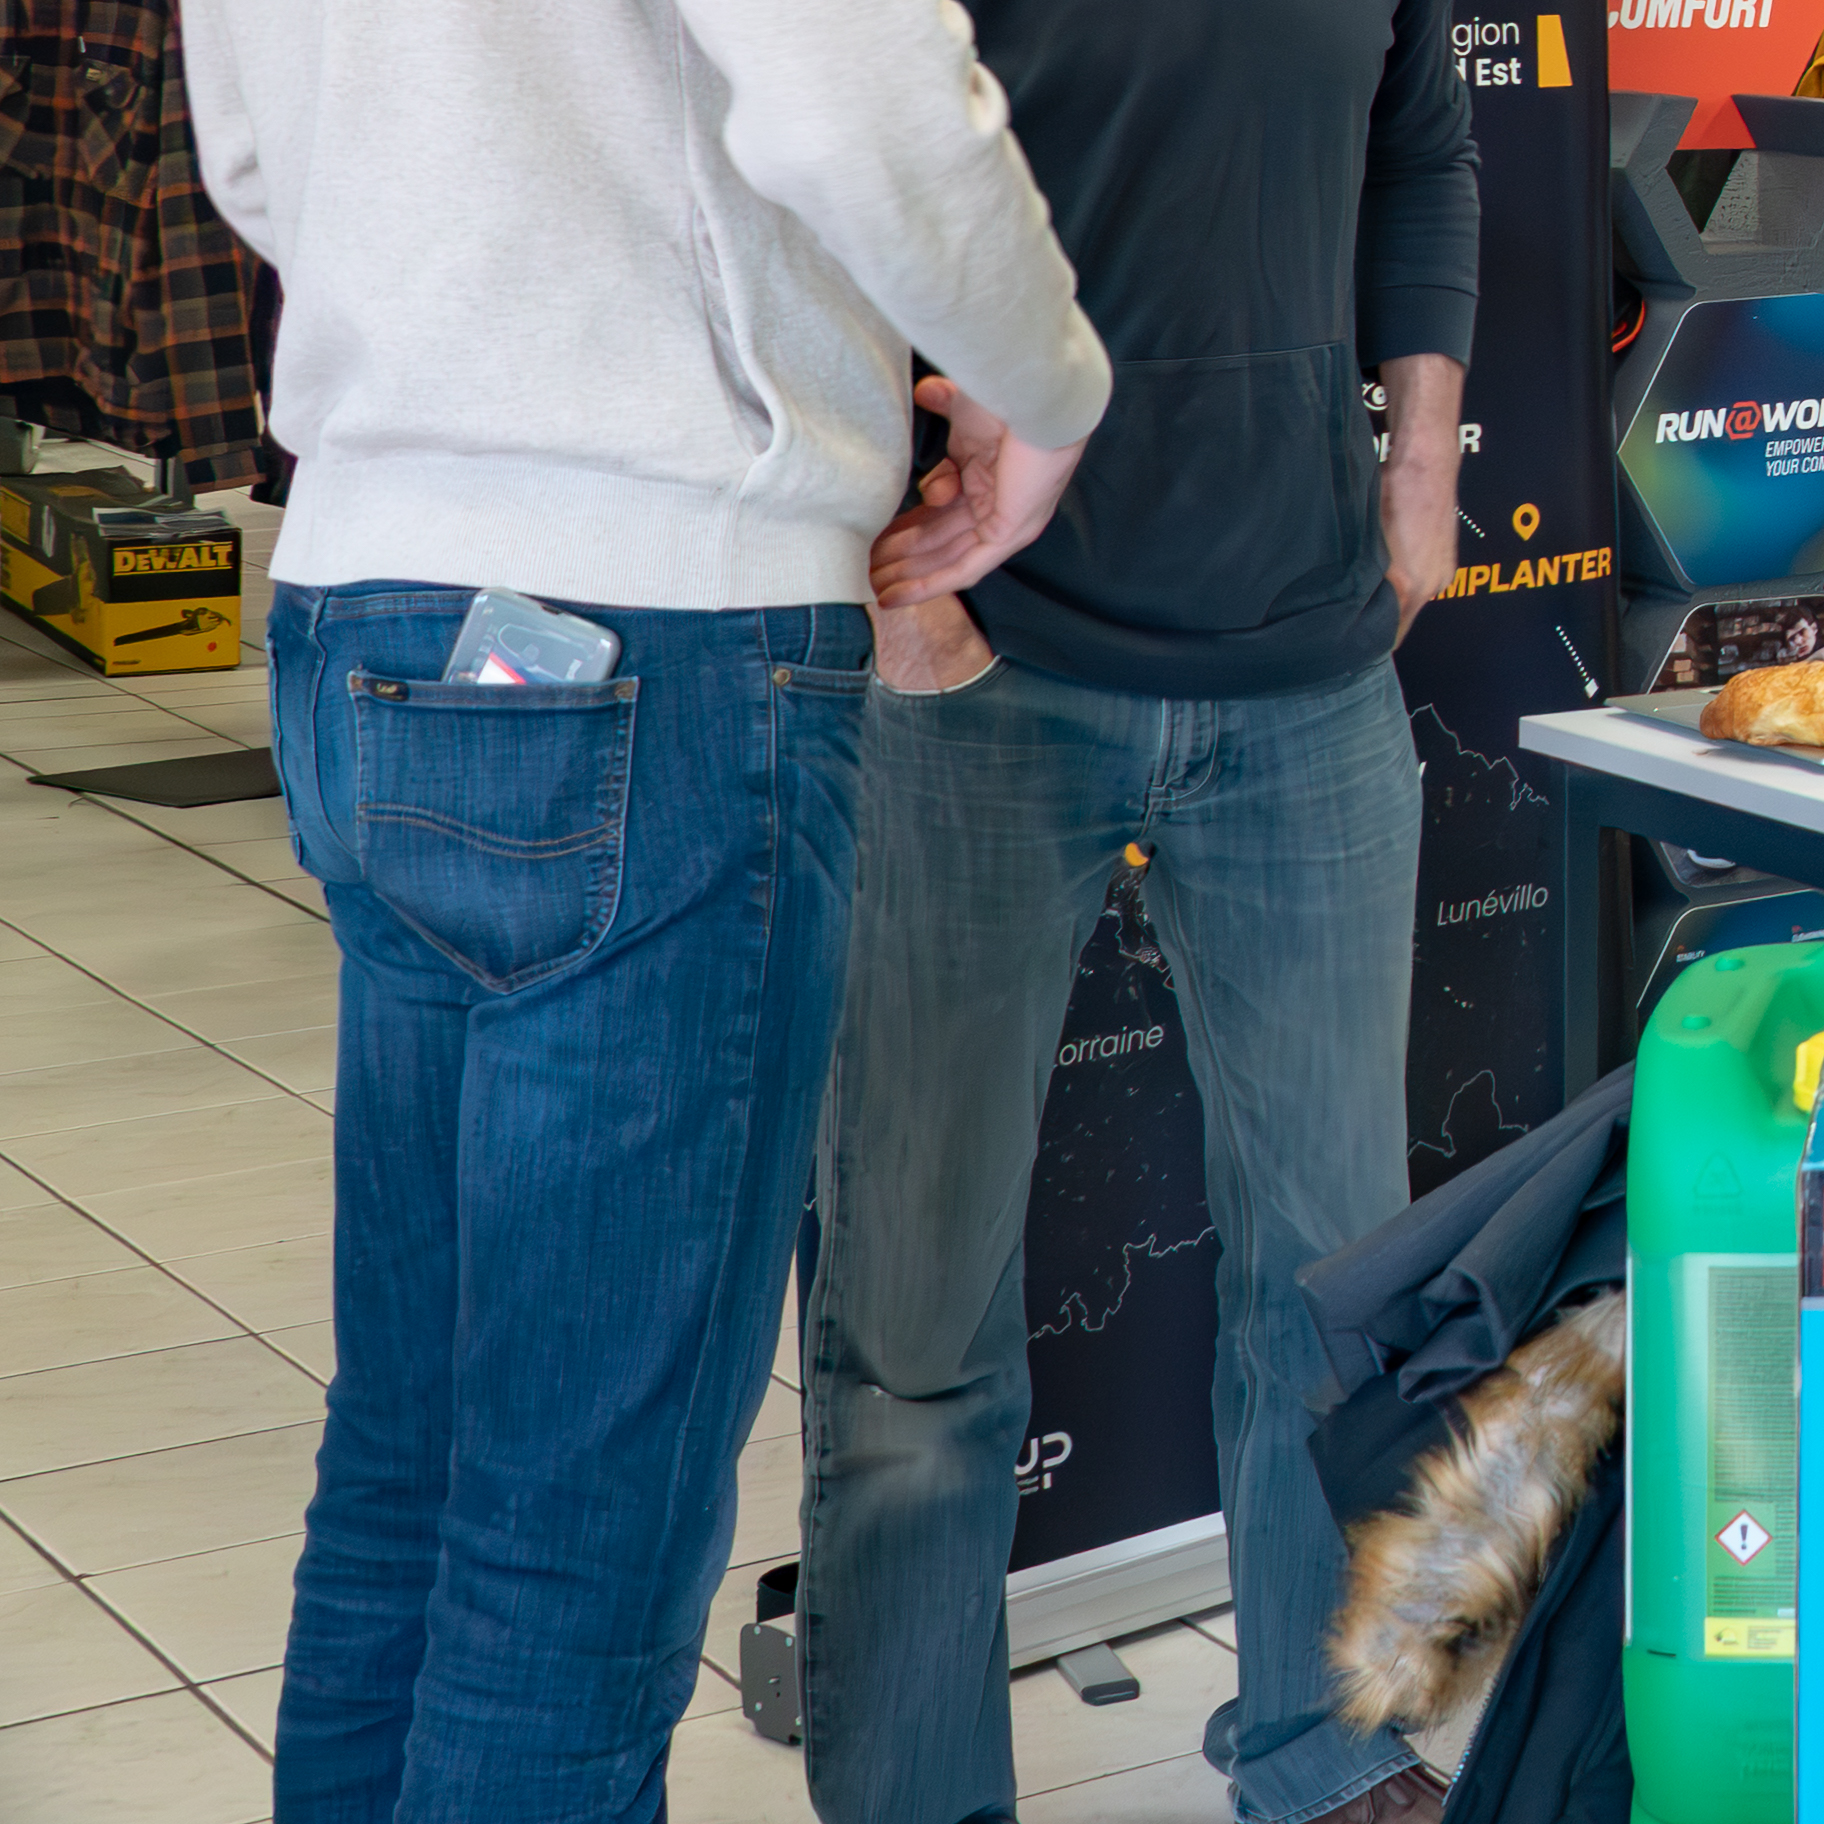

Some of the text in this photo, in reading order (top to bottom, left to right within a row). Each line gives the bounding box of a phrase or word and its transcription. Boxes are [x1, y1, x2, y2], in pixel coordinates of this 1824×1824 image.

[1451, 16, 1520, 57] gion
[1475, 56, 1522, 87] Est
[1766, 458, 1800, 477] YOUR
[1429, 546, 1612, 602] MPLANTER
[1053, 1025, 1165, 1068] orraine
